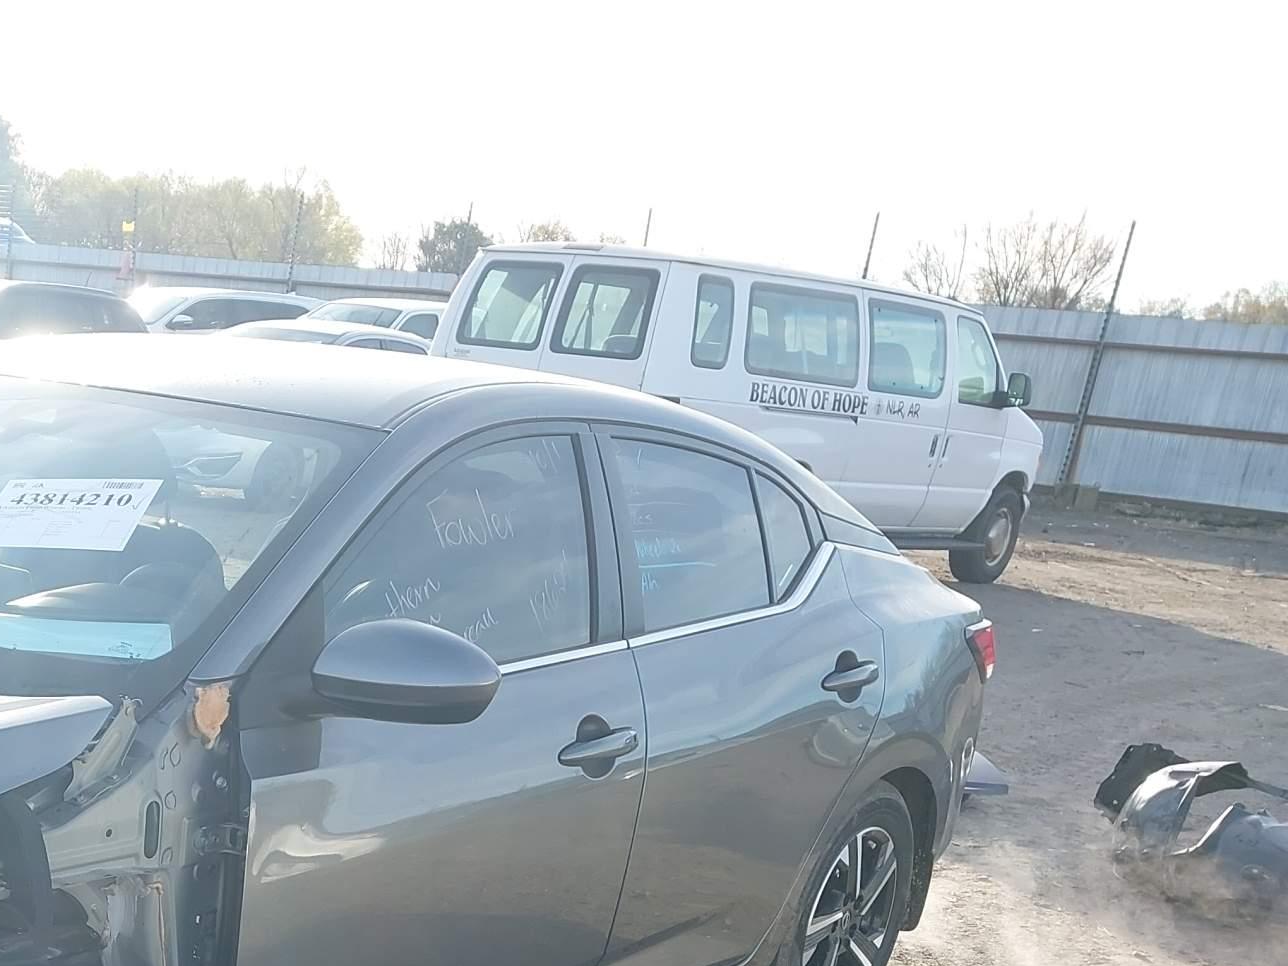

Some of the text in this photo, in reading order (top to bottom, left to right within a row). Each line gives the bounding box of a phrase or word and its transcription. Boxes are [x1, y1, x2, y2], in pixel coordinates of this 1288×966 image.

[749, 382, 808, 408] BEACON
[811, 390, 830, 410] OF
[832, 392, 869, 415] HOPE
[907, 402, 921, 418] AR
[10, 492, 133, 507] 43814210
[425, 487, 515, 549] Fowler
